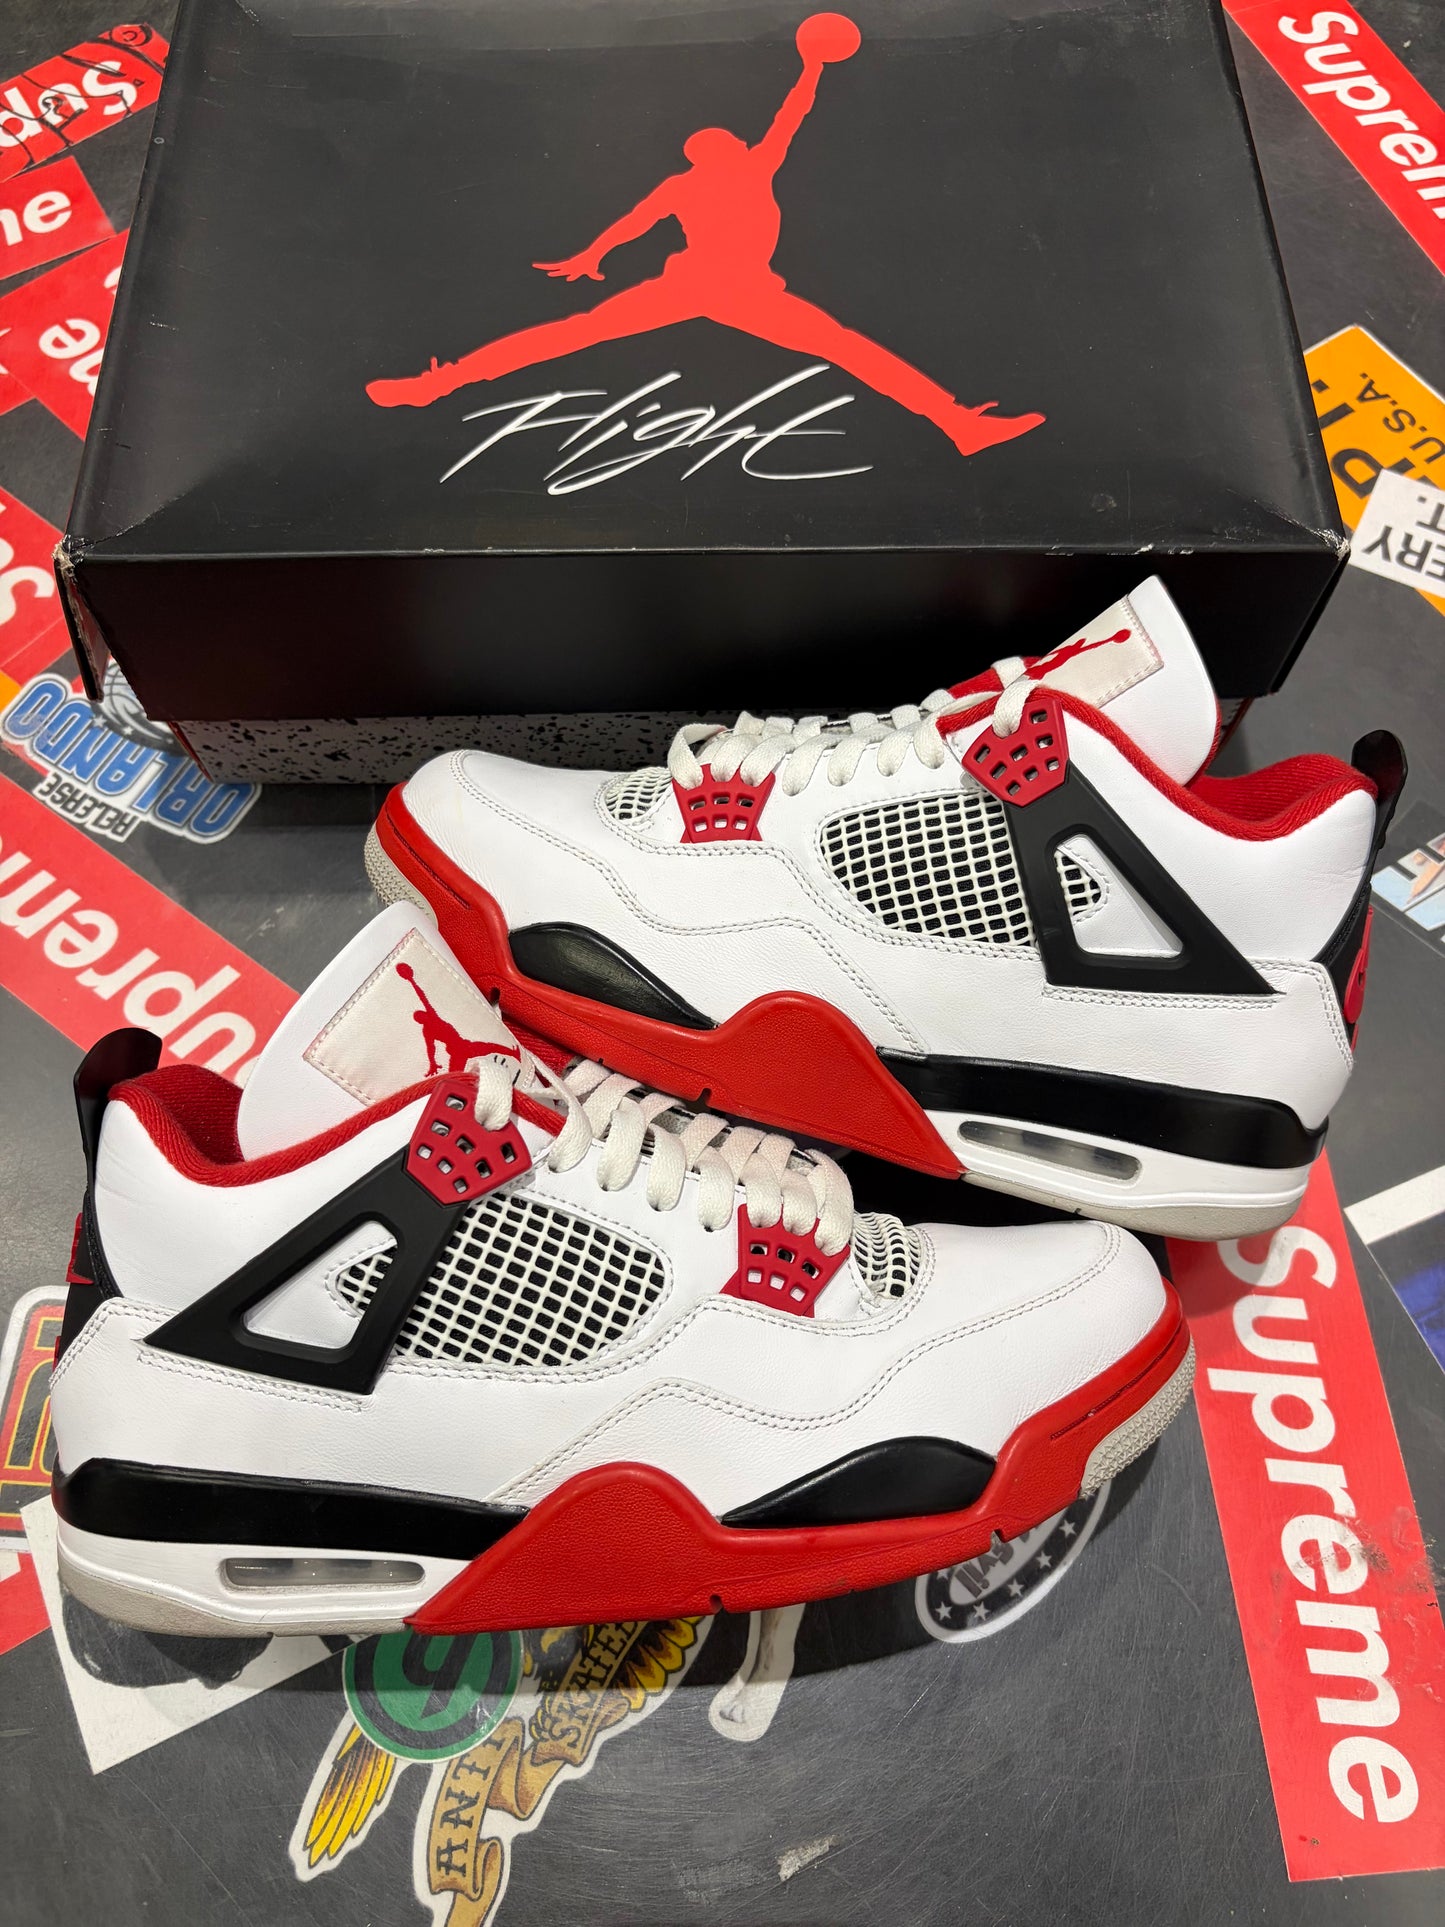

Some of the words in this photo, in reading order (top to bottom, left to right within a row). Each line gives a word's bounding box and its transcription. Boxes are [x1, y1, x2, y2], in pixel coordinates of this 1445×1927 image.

[440, 364, 874, 495] Flight
[1356, 372, 1445, 464] U.S.A.
[8, 678, 258, 837] ORLANDO
[40, 773, 140, 840] RELEASE
[0, 851, 262, 1090] uprem
[1206, 1225, 1419, 1824] Supreme
